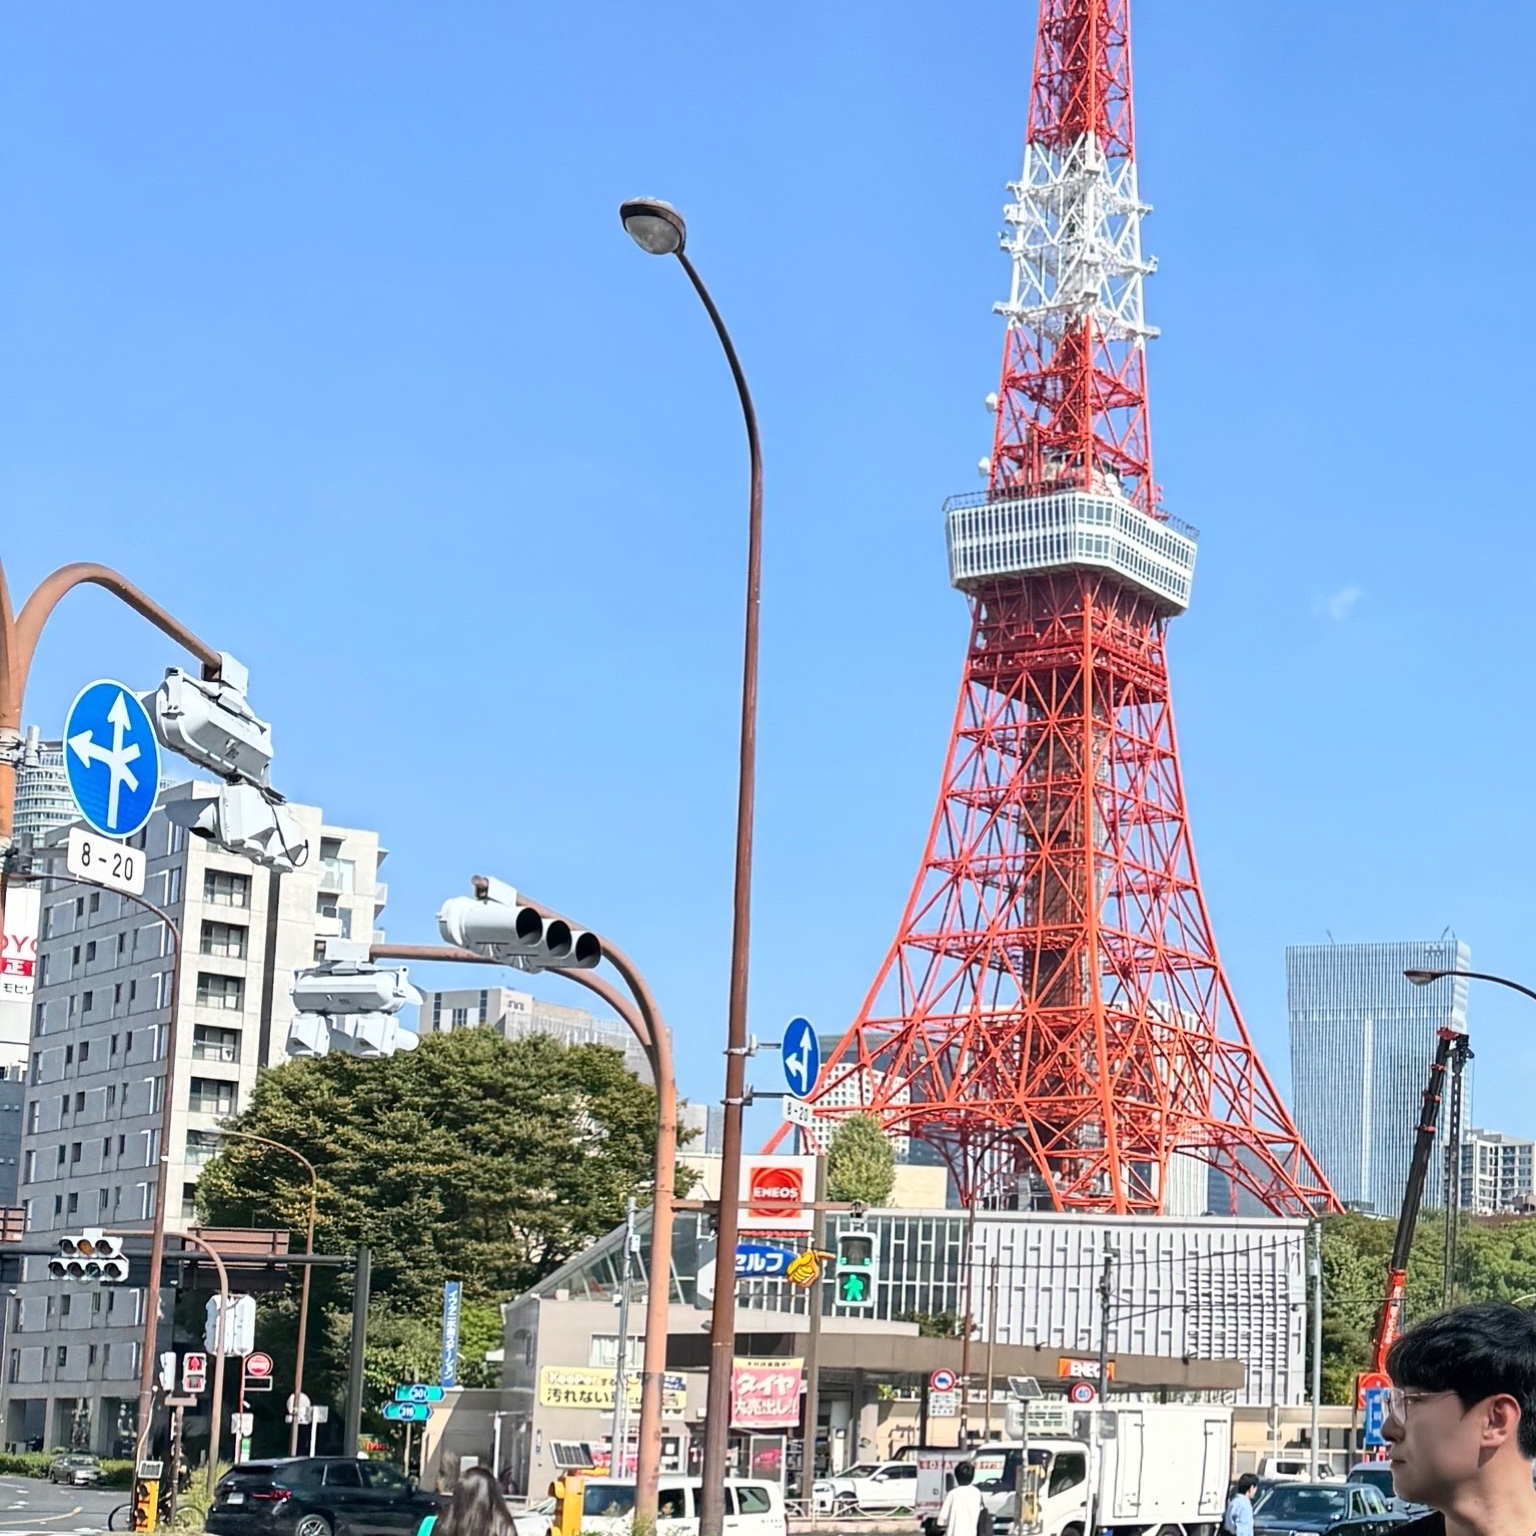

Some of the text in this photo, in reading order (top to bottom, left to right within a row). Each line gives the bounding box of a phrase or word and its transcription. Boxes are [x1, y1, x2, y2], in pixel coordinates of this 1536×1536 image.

[82, 842, 133, 881] 8-20
[753, 1187, 799, 1198] ENEOS
[737, 1373, 796, 1396] タイヤ
